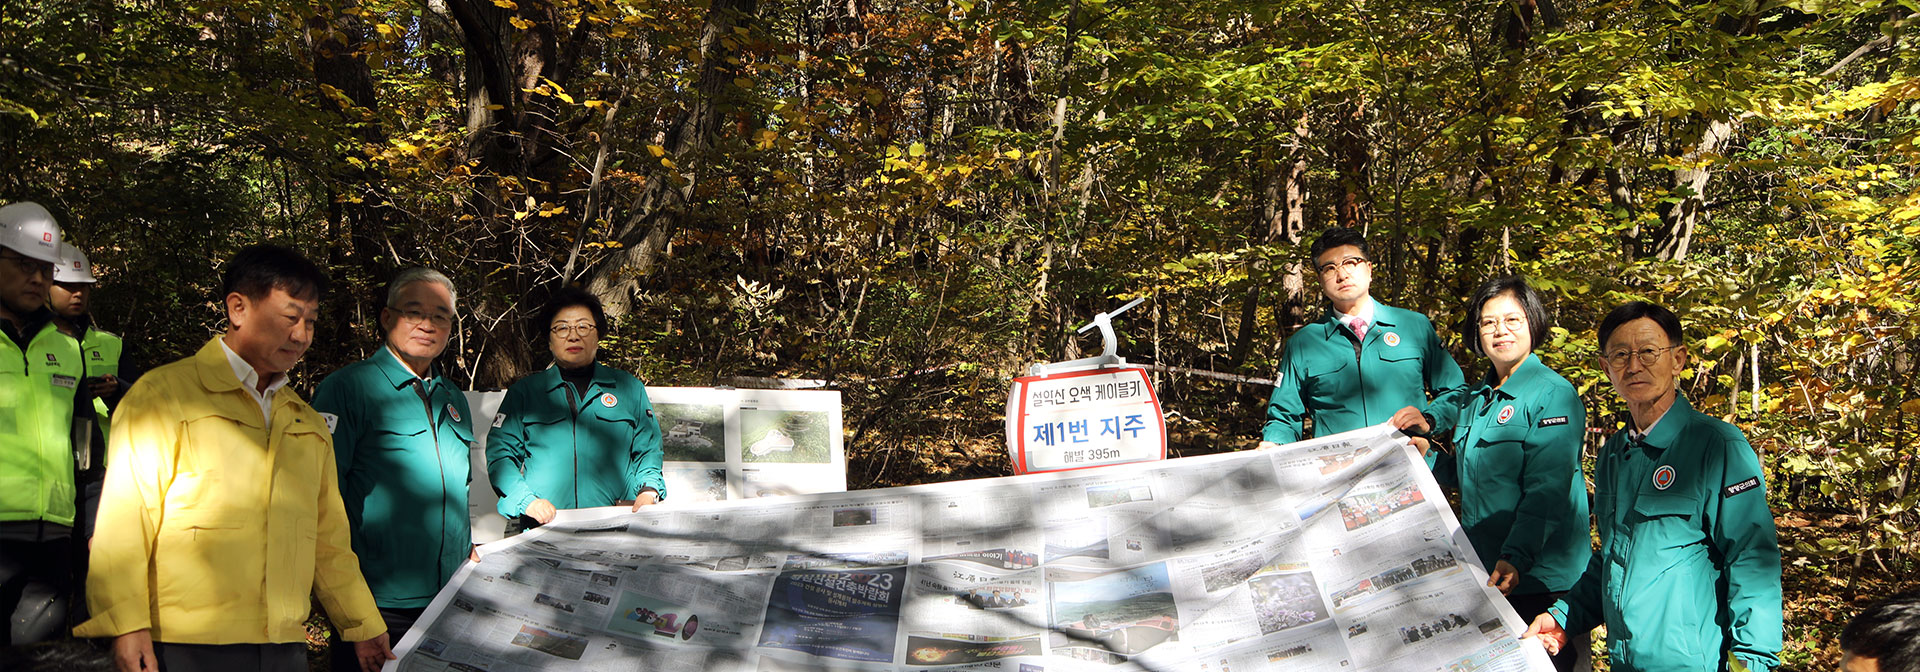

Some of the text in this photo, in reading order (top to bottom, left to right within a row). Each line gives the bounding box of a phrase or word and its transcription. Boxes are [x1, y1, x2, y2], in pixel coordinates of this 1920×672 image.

[1032, 380, 1141, 407] 설악산 오색 케이블카
[1033, 414, 1146, 446] 제1번 지주
[1063, 448, 1120, 463] 해발 395m
